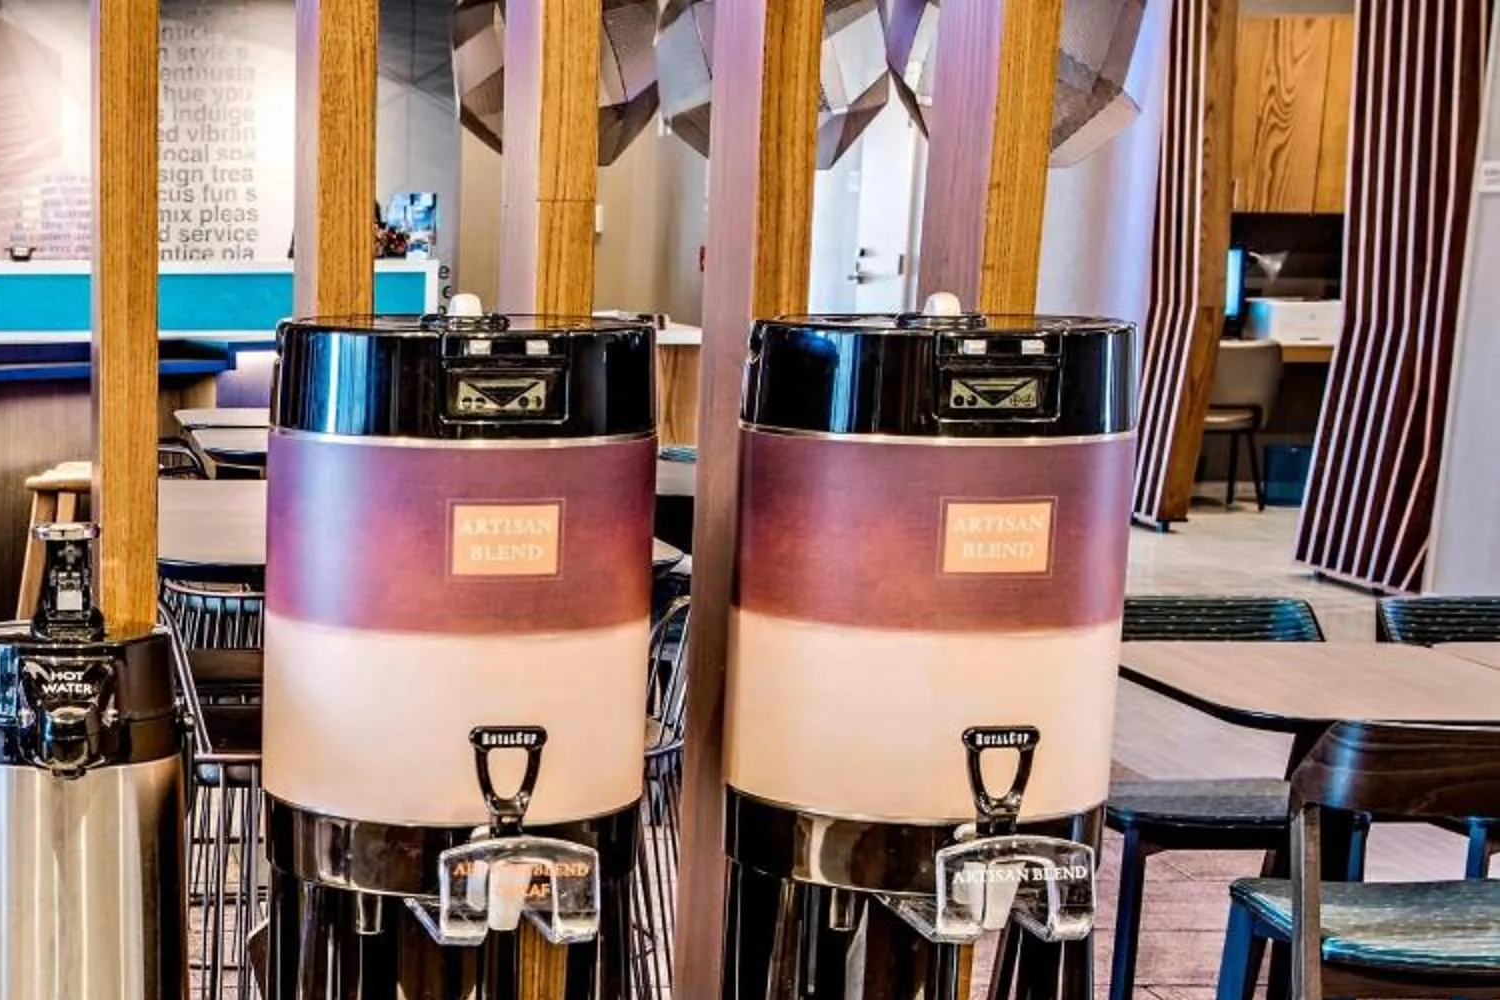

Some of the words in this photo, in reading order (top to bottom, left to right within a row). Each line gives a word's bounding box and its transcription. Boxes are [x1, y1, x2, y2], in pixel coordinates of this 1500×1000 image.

[173, 103, 255, 126] indulge
[212, 165, 254, 182] trea
[203, 183, 237, 203] fun
[200, 204, 259, 226] pleas
[179, 224, 259, 242] service
[459, 517, 551, 535] ARTISAN
[953, 514, 1045, 533] ARTISAN
[469, 544, 544, 561] BLEND
[962, 542, 1035, 560] BLEND
[51, 671, 84, 681] HOT
[41, 683, 93, 695] WATER
[953, 868, 1030, 884] ARTISAN
[1032, 865, 1088, 881] BLEND
